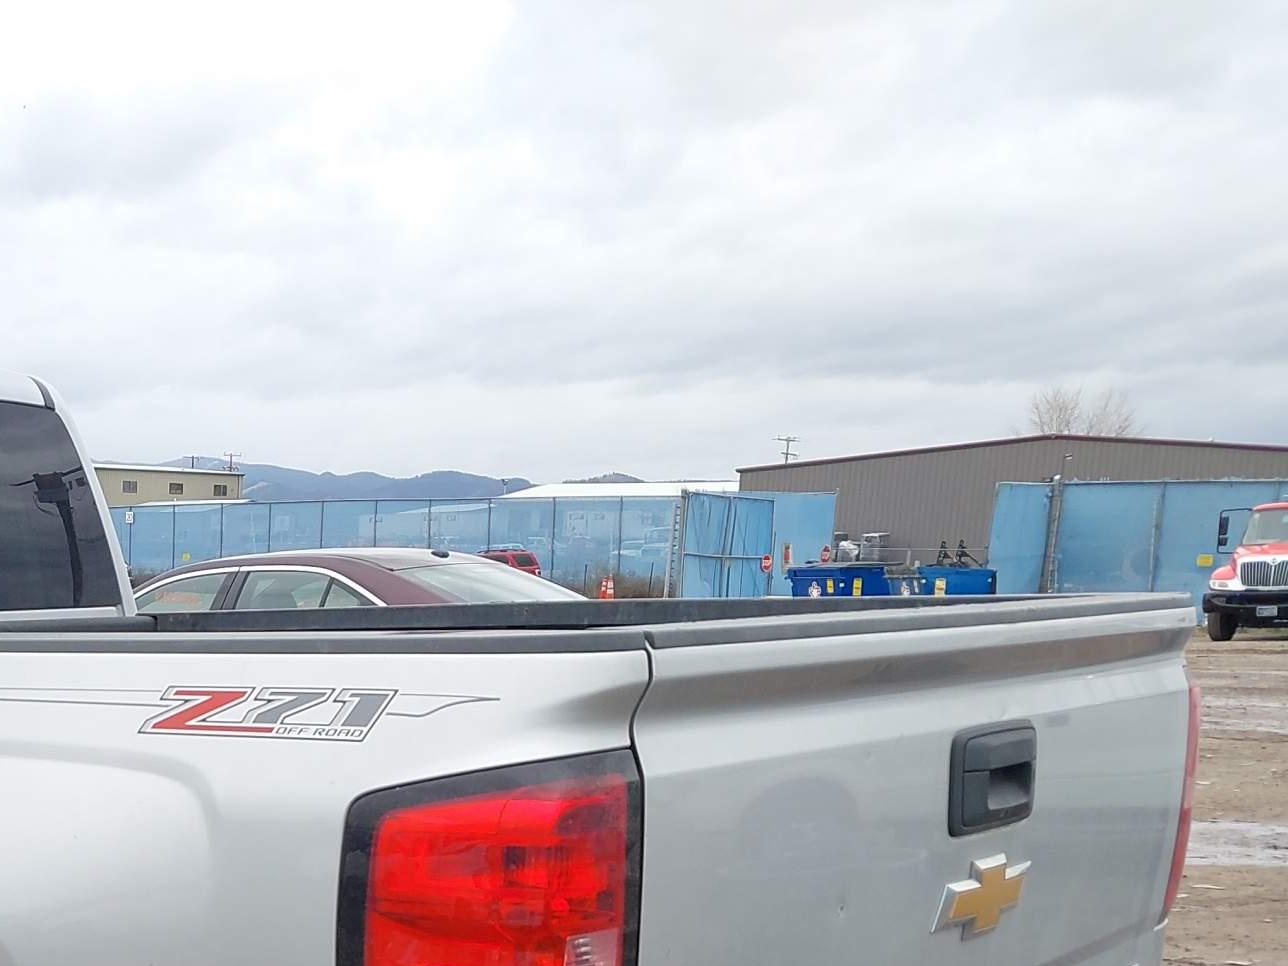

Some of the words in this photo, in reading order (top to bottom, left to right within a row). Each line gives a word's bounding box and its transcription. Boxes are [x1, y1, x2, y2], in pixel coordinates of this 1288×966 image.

[139, 686, 398, 735] Z71
[275, 726, 310, 736] OFF
[313, 727, 364, 738] ROAD
